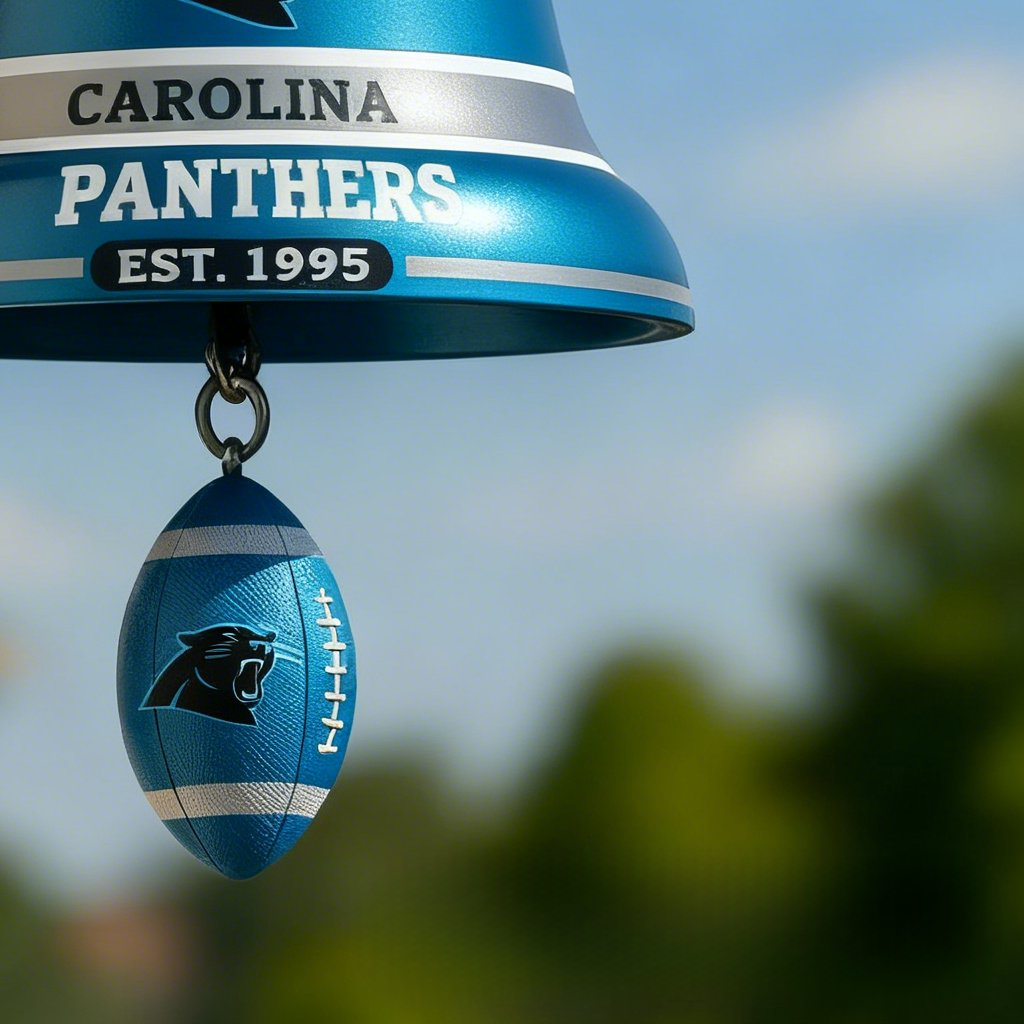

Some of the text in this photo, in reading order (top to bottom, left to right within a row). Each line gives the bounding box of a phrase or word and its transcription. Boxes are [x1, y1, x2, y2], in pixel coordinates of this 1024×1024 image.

[67, 77, 398, 126] CAROLINA
[54, 158, 464, 227] PANTHERS
[117, 247, 370, 284] EST. 1995
